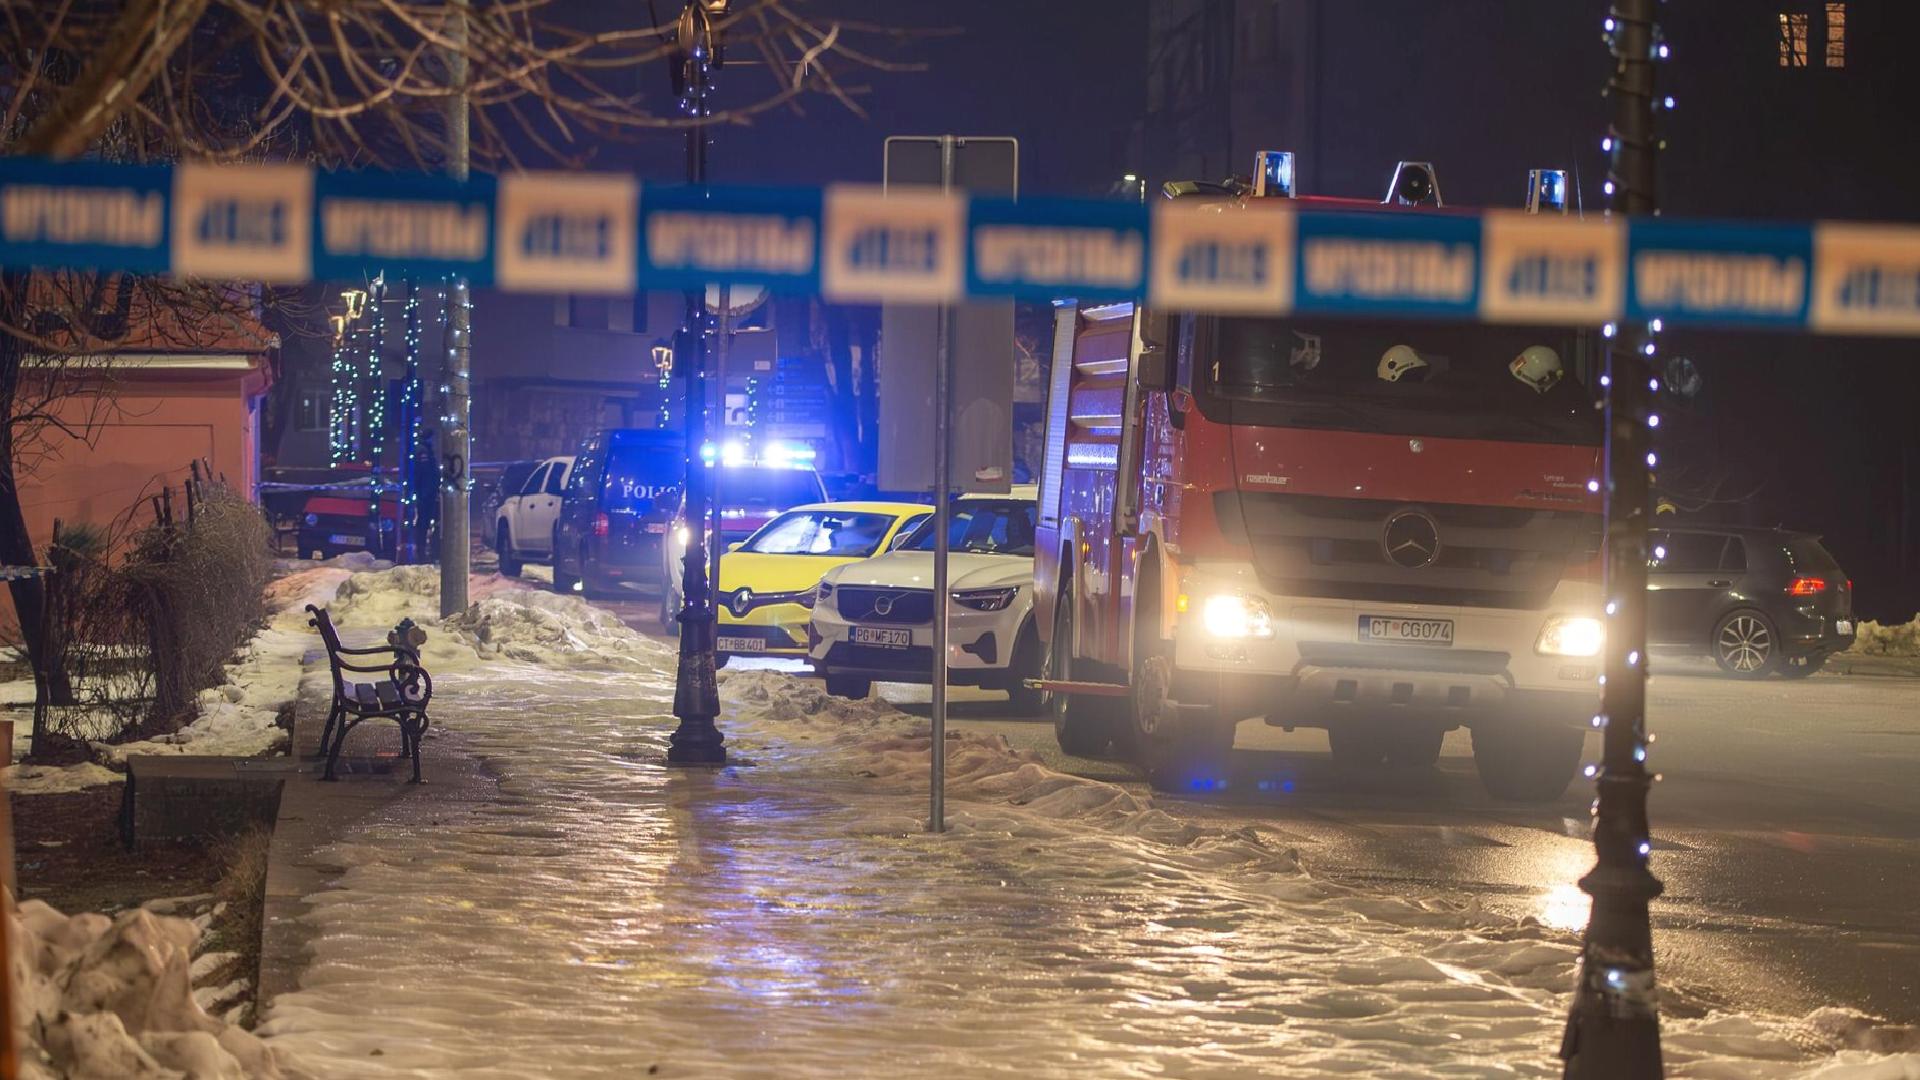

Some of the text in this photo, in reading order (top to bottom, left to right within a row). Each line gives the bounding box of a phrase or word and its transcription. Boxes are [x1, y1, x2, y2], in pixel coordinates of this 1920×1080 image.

[1212, 360, 1219, 381] 1
[856, 628, 869, 641] PG
[1371, 620, 1450, 640] CT CG074
